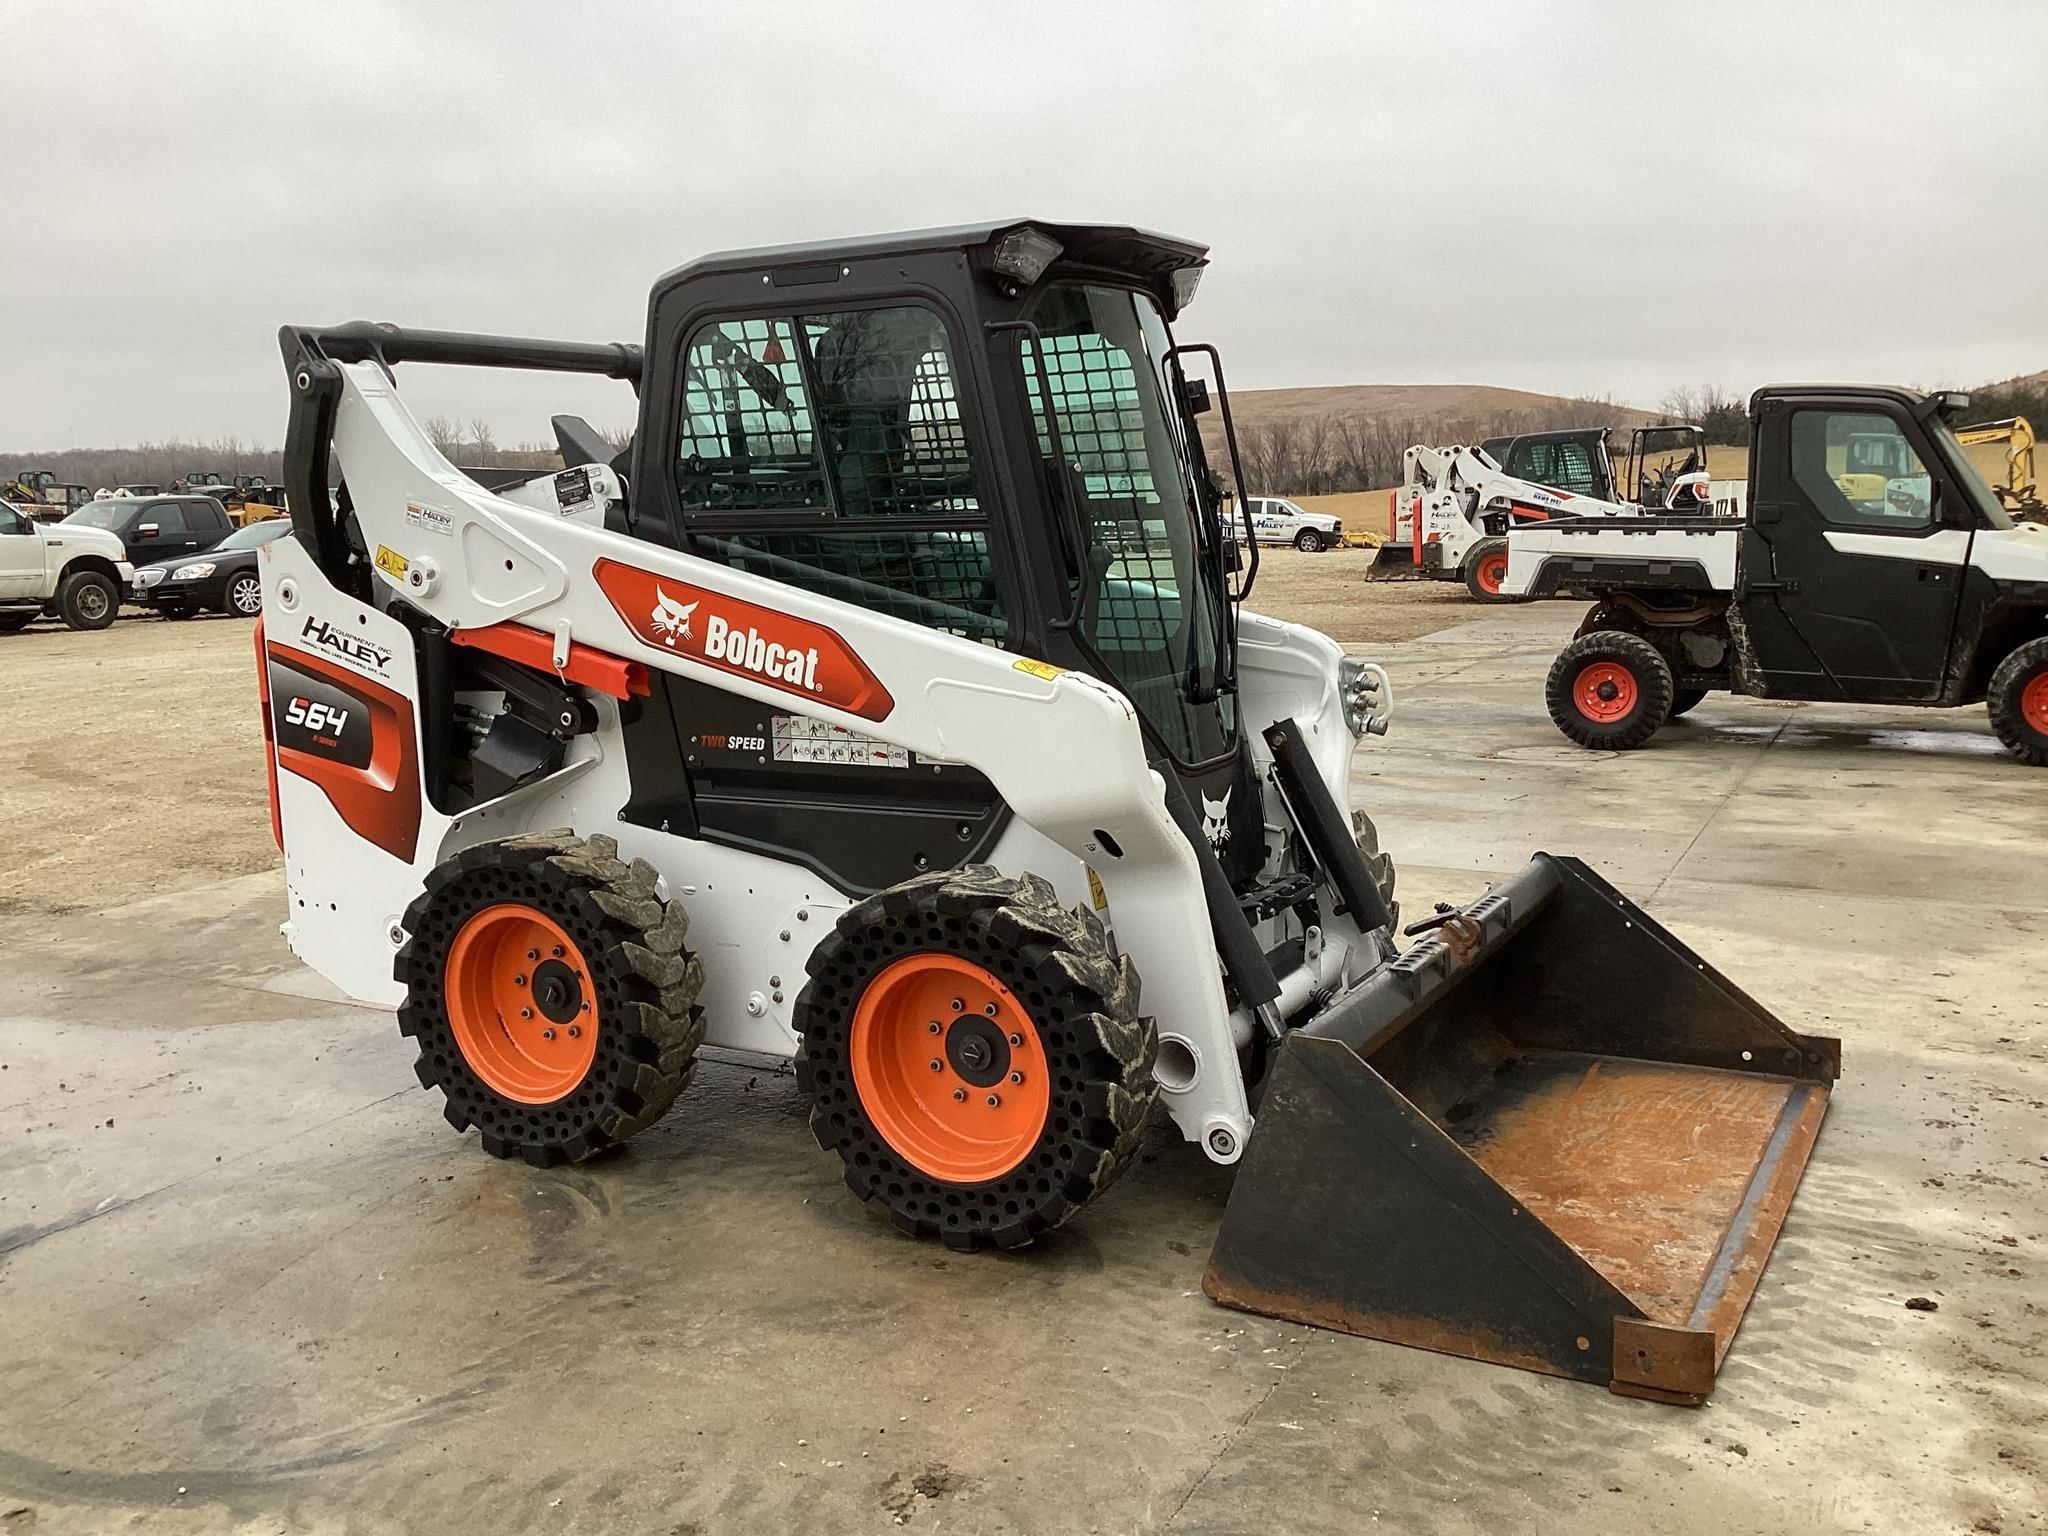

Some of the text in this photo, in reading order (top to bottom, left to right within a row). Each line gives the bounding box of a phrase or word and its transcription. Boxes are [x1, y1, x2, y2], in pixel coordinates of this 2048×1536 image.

[1256, 520, 1284, 528] HALEY
[302, 616, 392, 668] HALEY
[330, 627, 376, 649] EQUIPMENT
[704, 614, 819, 690] Bobcat
[285, 697, 349, 737] S64
[701, 735, 765, 751] TWO SPEED
